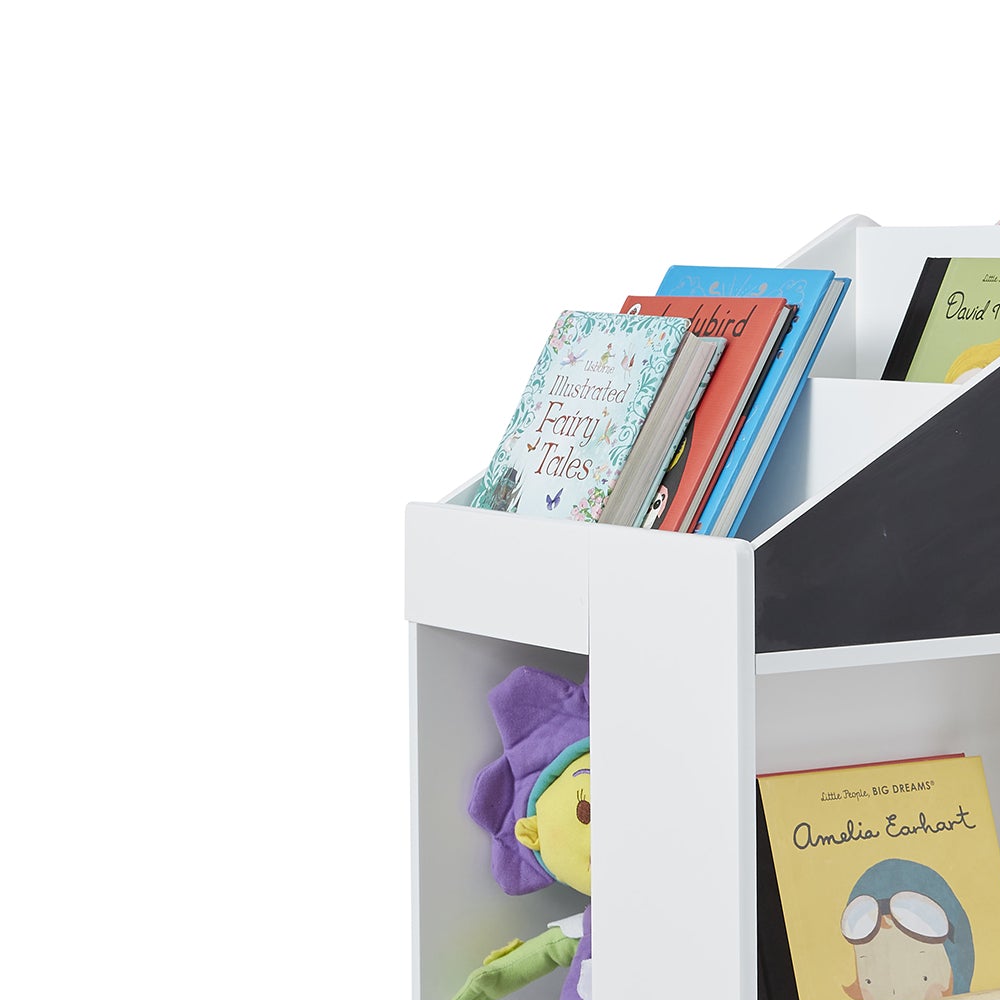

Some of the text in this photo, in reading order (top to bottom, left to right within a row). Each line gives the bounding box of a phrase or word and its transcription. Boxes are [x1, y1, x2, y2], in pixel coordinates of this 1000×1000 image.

[946, 291, 991, 320] David
[583, 360, 615, 374] Usborne
[548, 374, 631, 403] Illustrated
[536, 400, 600, 448] Fairy
[534, 442, 593, 480] Tales
[820, 791, 842, 802] Little
[842, 788, 871, 802] People,
[872, 786, 889, 796] BIG
[793, 805, 977, 850] Amelia Earhart
